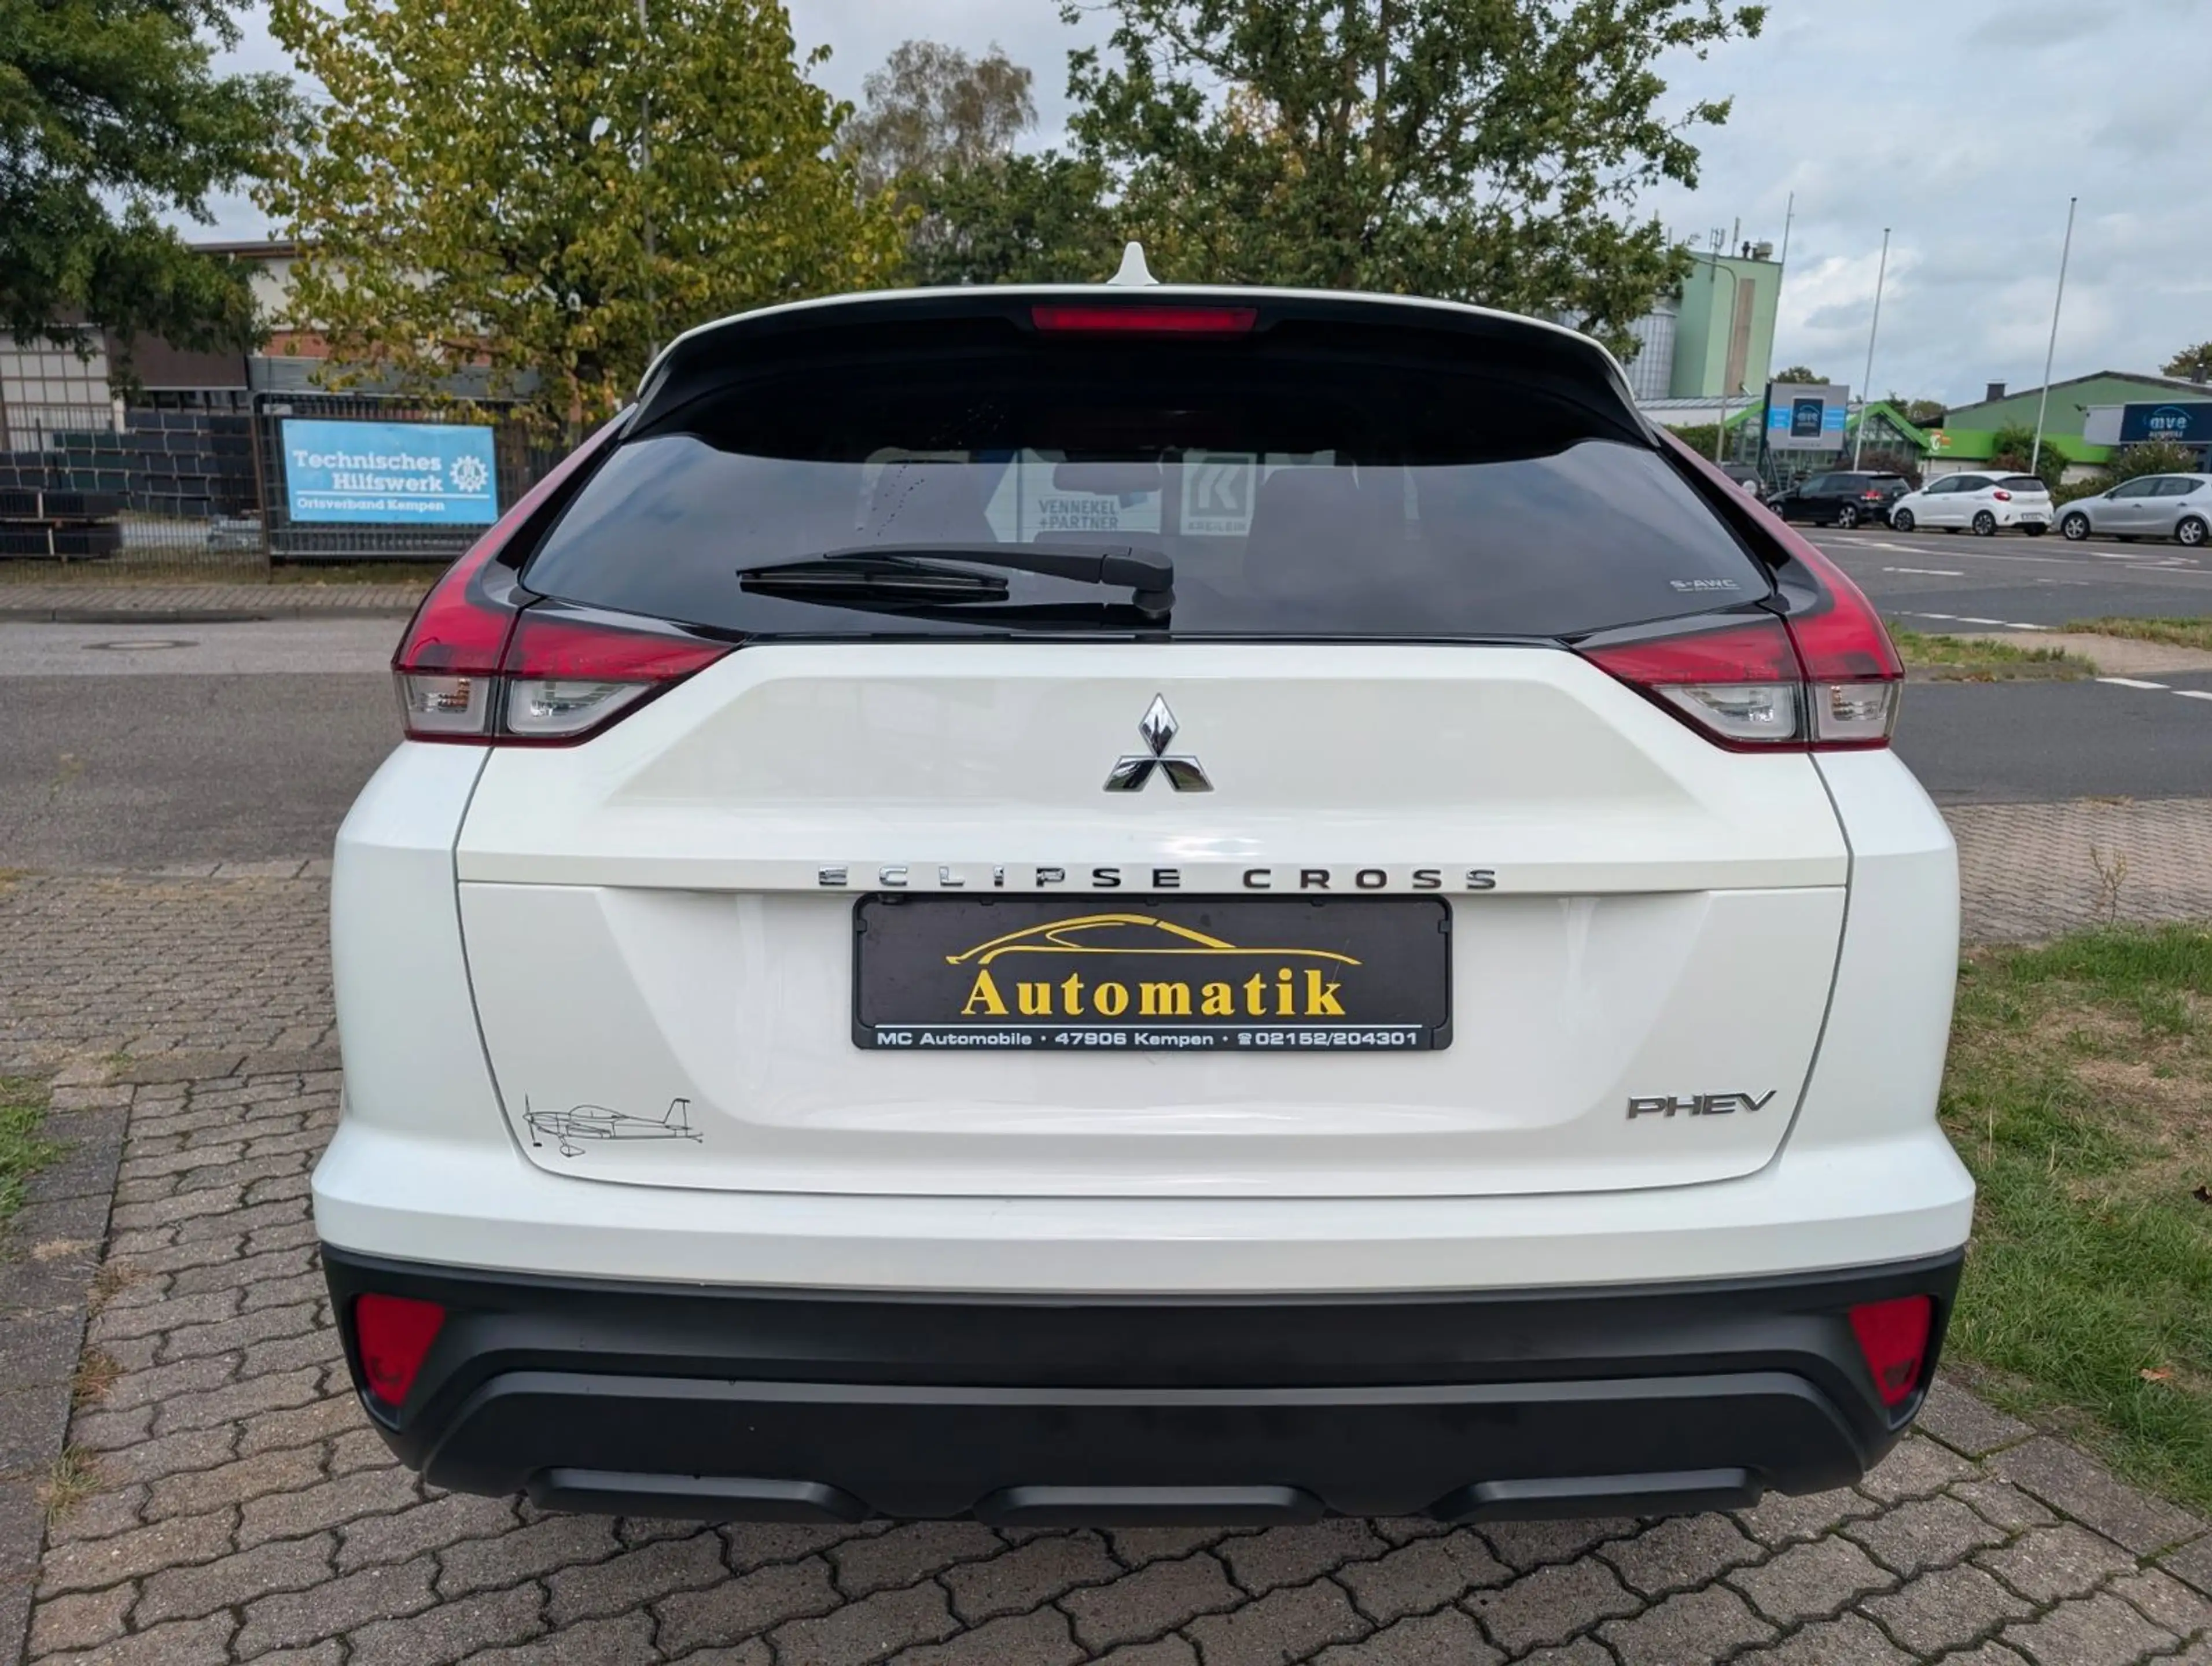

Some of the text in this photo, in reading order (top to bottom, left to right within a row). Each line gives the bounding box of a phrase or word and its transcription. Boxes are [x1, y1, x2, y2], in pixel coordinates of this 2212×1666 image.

[292, 449, 443, 471] Technisches
[332, 472, 444, 492] Hilfswerk
[297, 497, 445, 513] Ortsverband Kempen
[819, 867, 1497, 890] ECLIPSE CROSS
[960, 968, 1346, 1016] Automatik
[877, 1033, 912, 1045] MC
[919, 1033, 1032, 1045] Automobile
[1055, 1033, 1127, 1045] 47906
[1135, 1033, 1214, 1048] Kempen
[1626, 1089, 1777, 1119] PHEV
